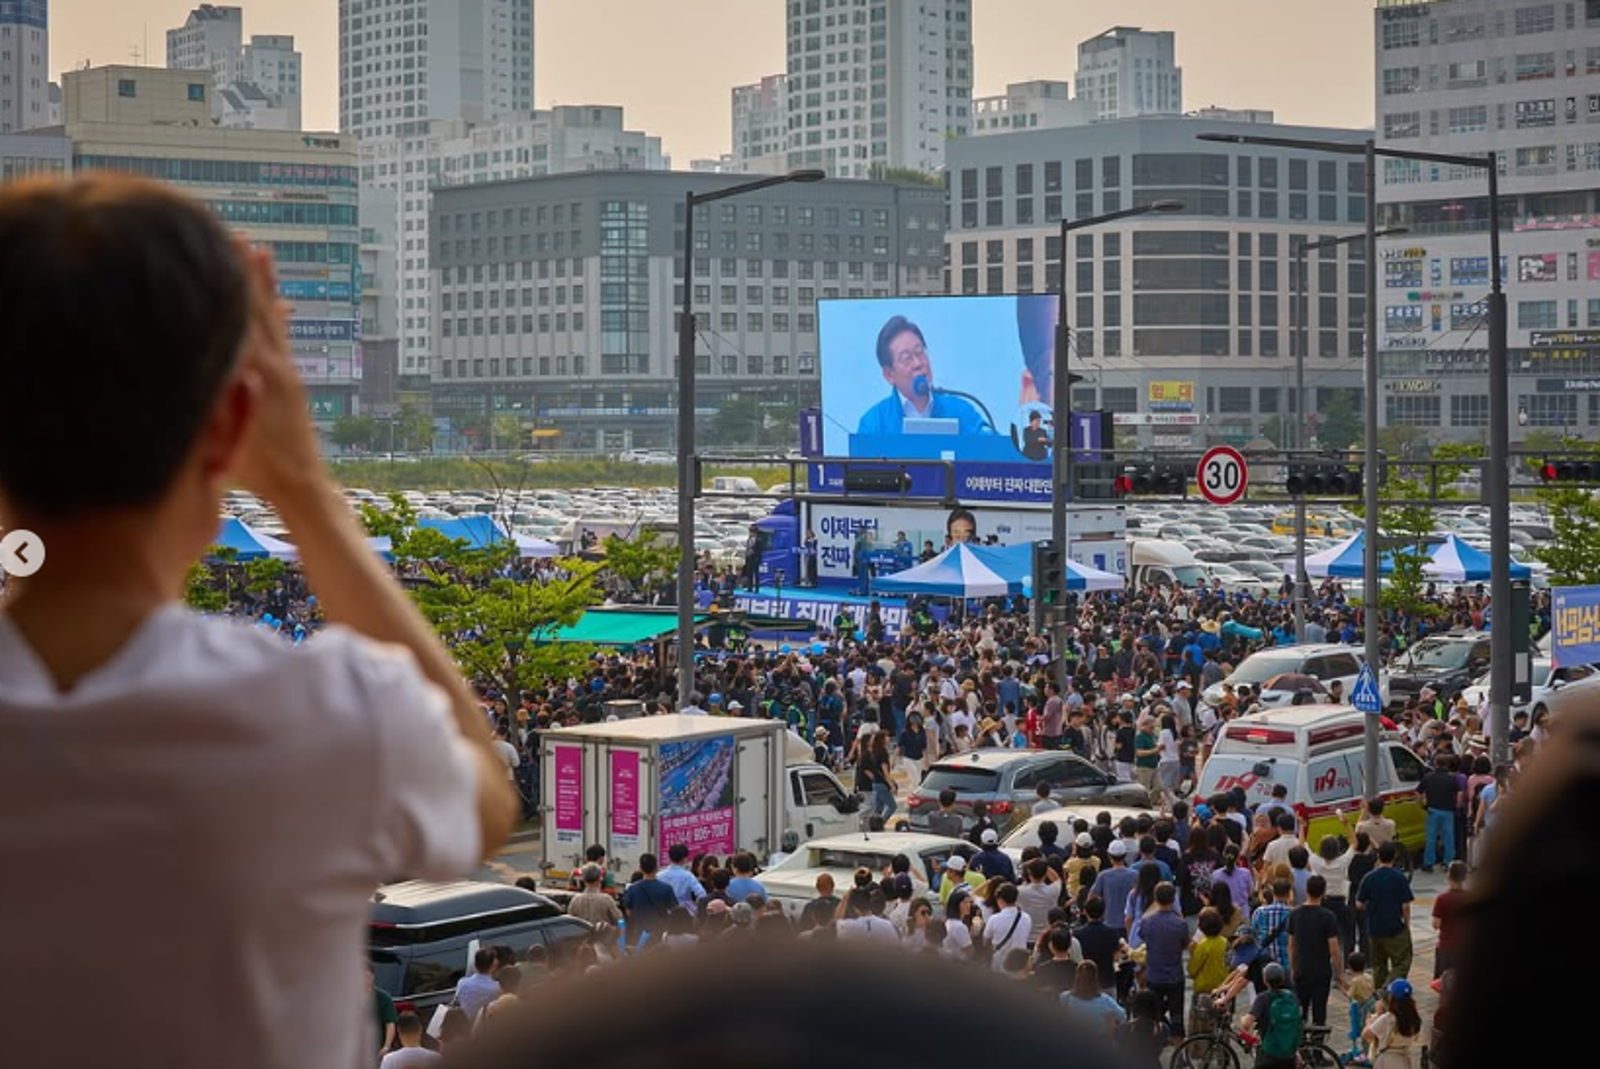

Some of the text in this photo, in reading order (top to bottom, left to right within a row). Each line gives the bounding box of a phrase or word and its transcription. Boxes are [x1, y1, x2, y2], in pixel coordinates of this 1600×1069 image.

[807, 416, 817, 451] 1
[1080, 418, 1092, 456] 1
[817, 464, 825, 486] 1
[965, 476, 1053, 494] 이제부터 진짜 대한민
[1207, 461, 1239, 489] 30
[821, 545, 851, 569] 진짜
[1215, 771, 1260, 791] 119
[1313, 767, 1337, 793] 119
